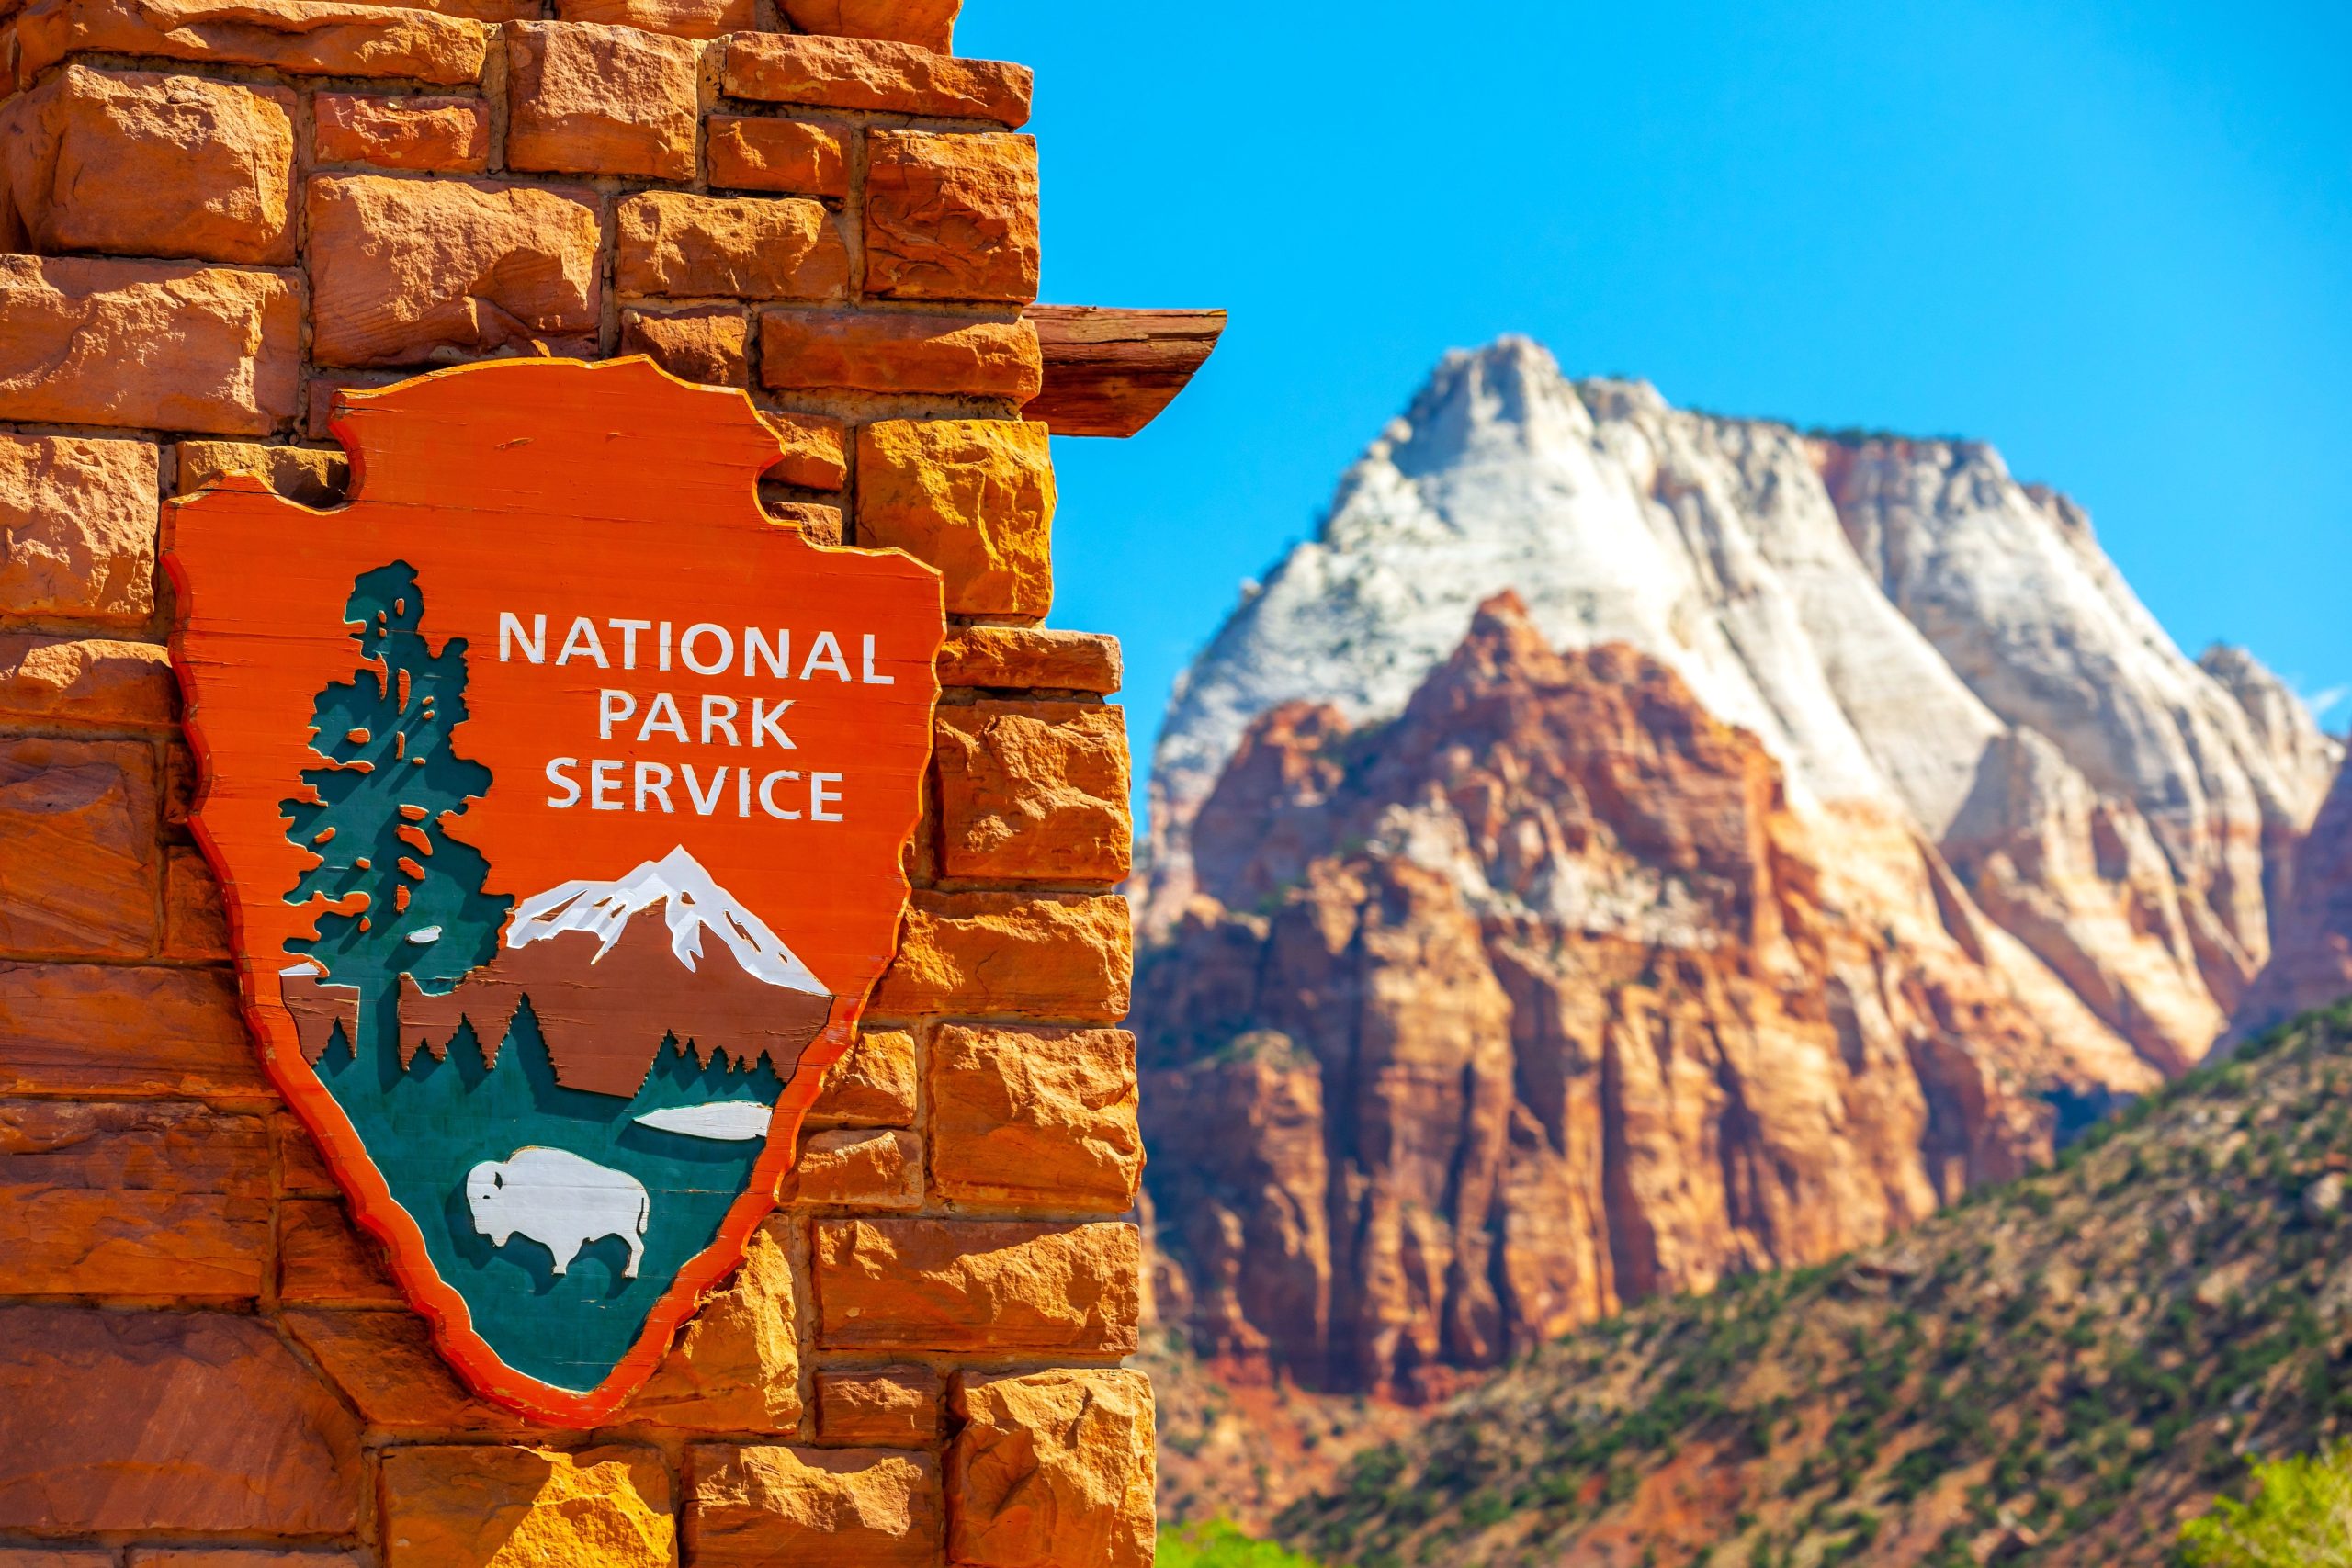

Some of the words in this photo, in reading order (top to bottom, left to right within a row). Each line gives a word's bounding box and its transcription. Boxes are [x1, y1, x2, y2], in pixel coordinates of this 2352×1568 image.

[498, 611, 896, 685] NATIONAL
[598, 688, 798, 750] PARK
[544, 756, 844, 823] SERVICE
